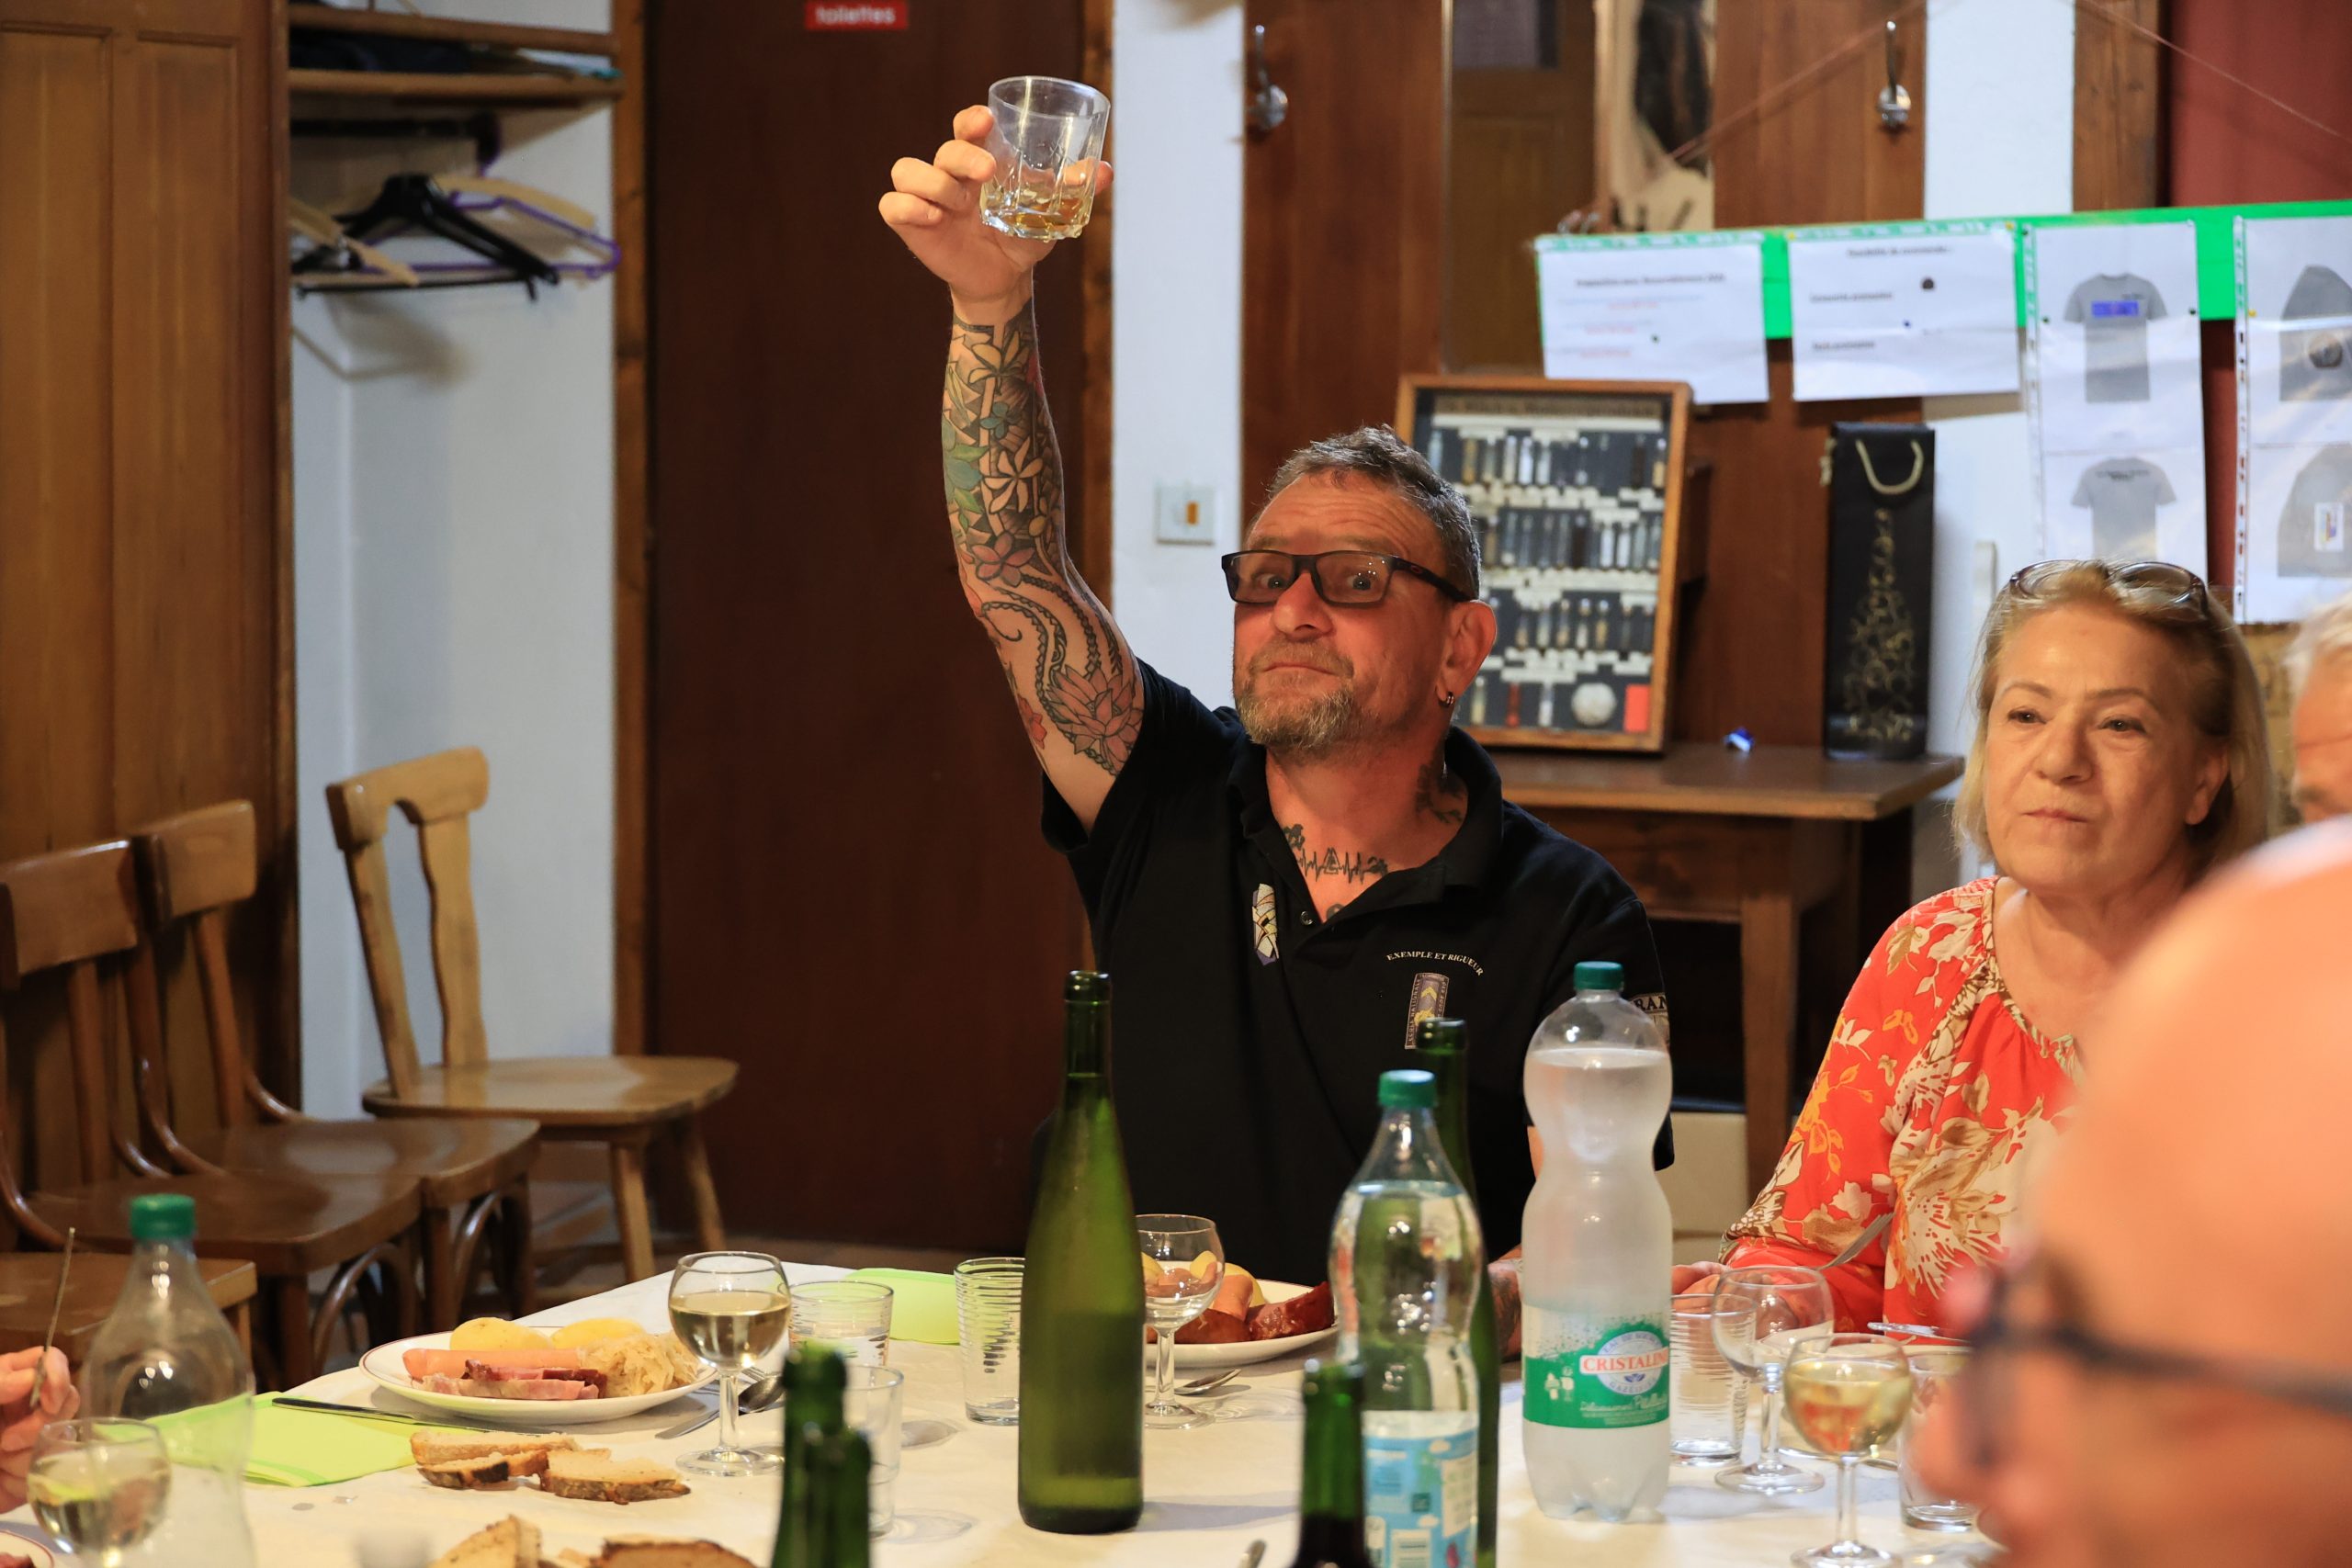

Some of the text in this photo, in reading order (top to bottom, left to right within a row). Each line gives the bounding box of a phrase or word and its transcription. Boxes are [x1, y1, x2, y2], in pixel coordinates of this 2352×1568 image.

[815, 6, 896, 25] toilettes
[1386, 951, 1484, 976] EXEMPLE ET RIGUEUR
[1583, 1348, 1668, 1371] CRISTALIN
